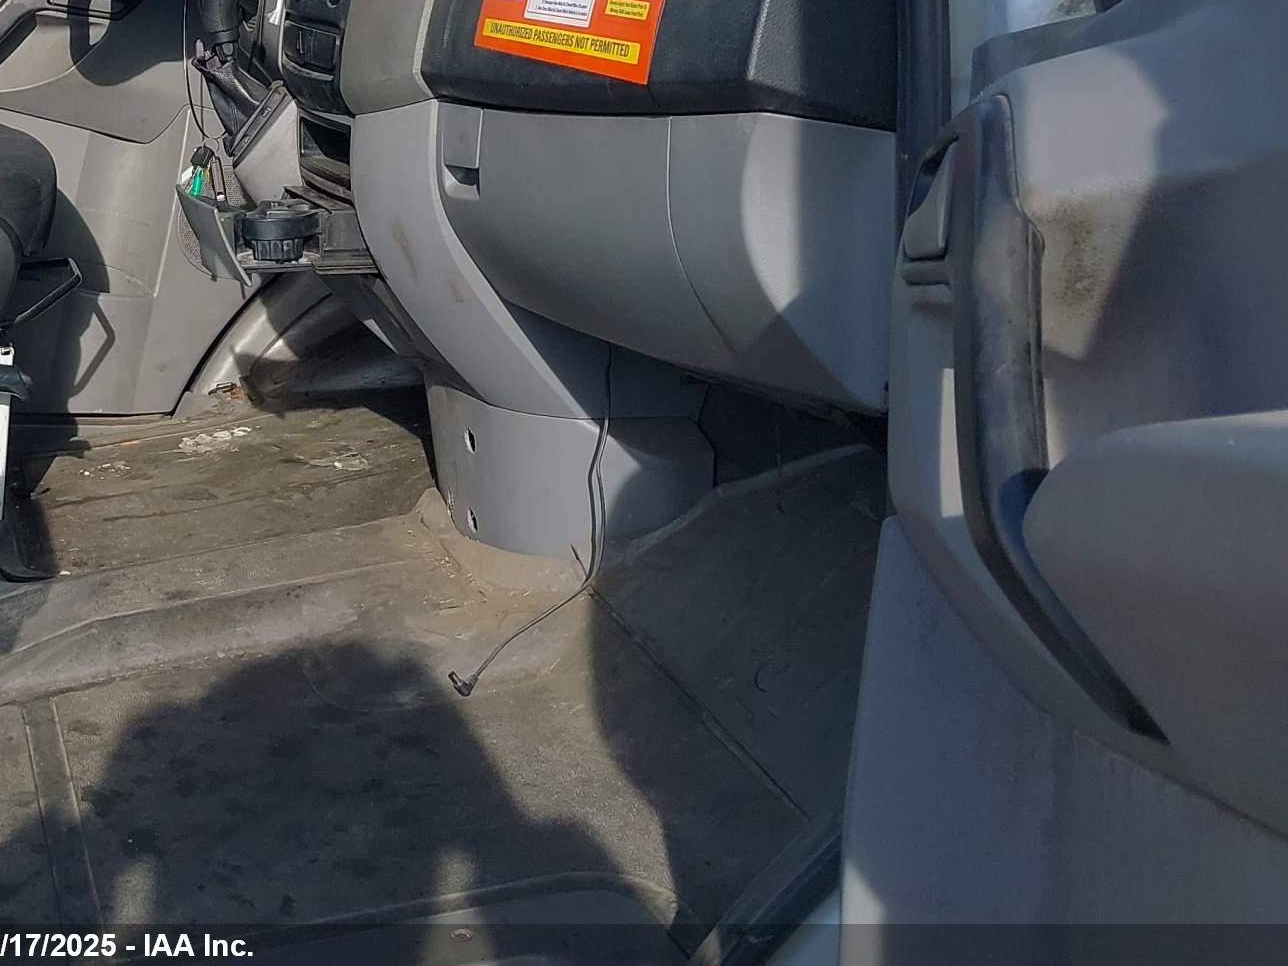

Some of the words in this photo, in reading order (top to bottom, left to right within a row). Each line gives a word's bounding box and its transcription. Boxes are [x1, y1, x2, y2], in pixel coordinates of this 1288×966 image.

[490, 22, 533, 40] UNAUTHORIZED
[533, 28, 575, 48] PASSENGERS
[574, 35, 588, 51] NOT
[589, 38, 630, 58] PERMITTED
